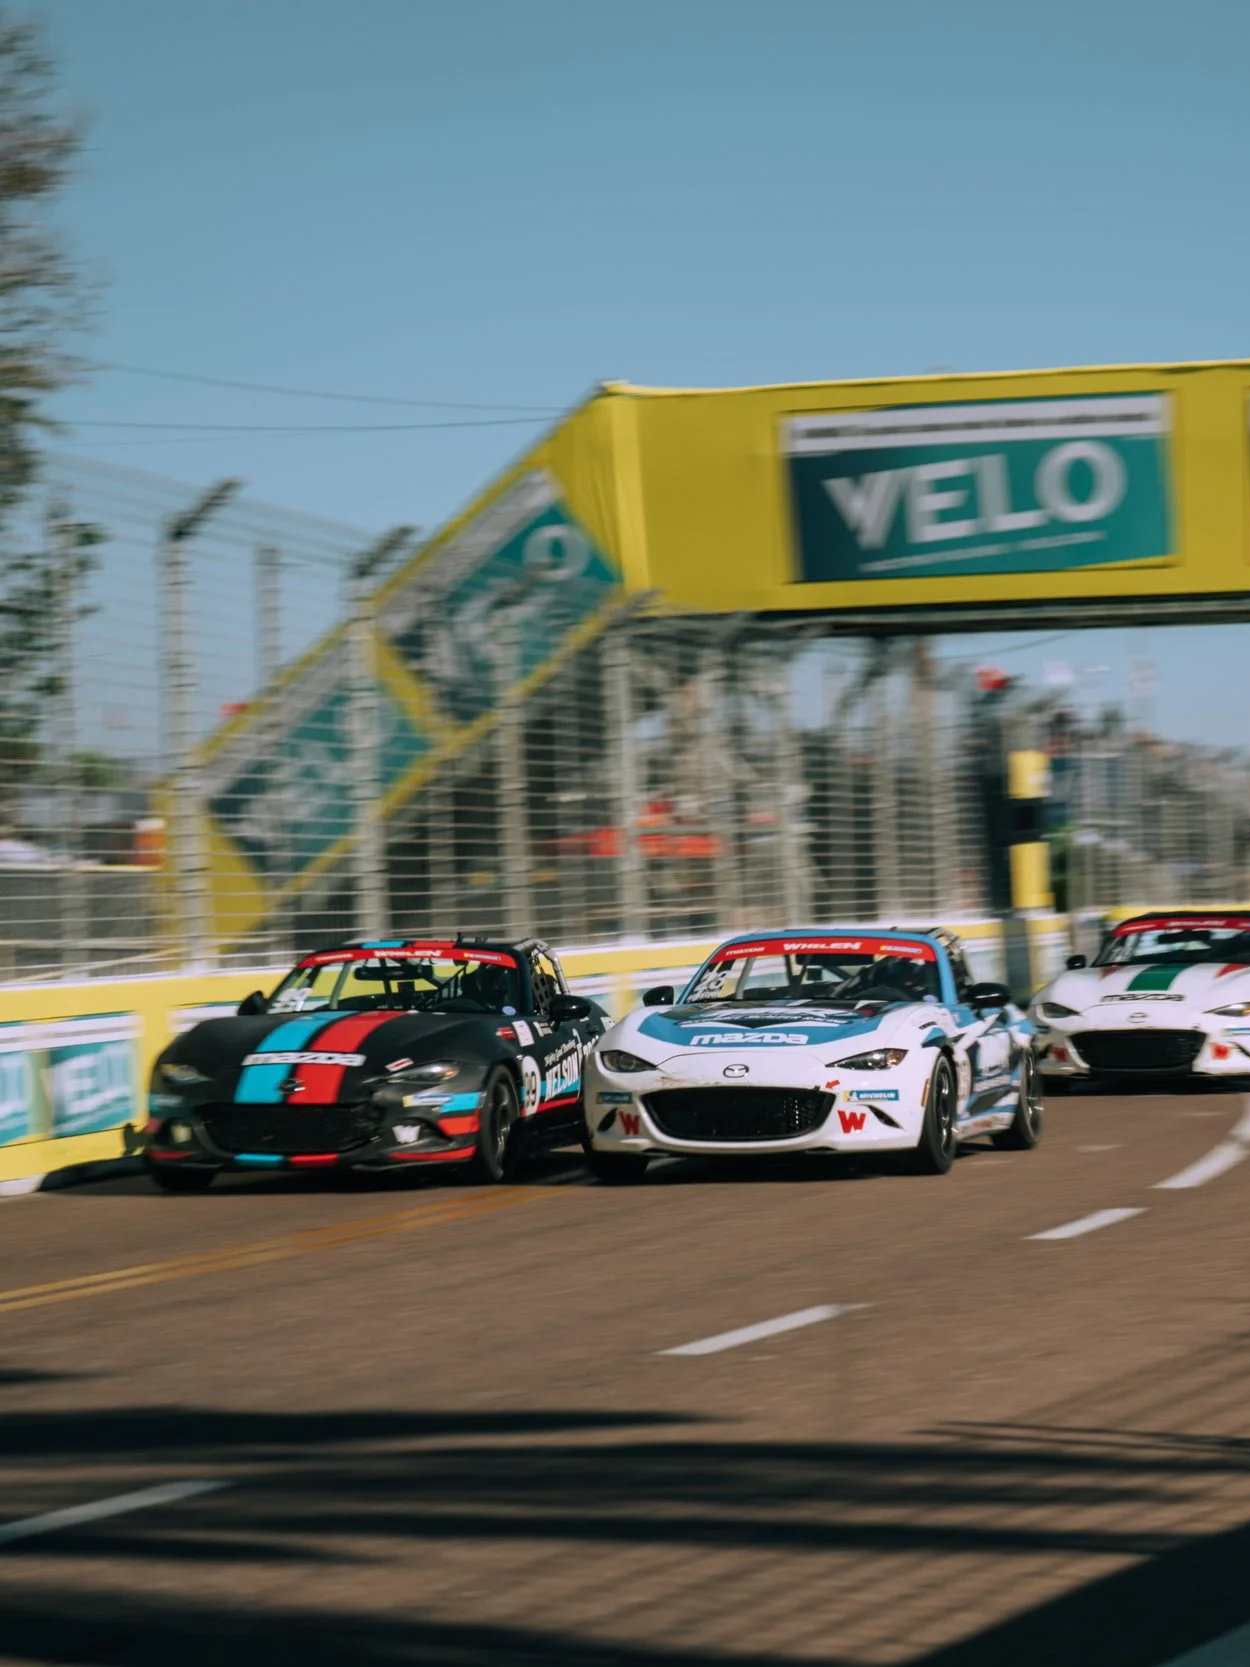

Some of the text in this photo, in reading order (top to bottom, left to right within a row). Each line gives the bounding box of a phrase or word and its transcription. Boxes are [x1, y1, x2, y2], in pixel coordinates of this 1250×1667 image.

[821, 440, 1127, 549] VELO
[783, 942, 862, 951] WHELEN
[690, 1032, 809, 1046] mazda
[544, 1051, 580, 1103] NELSON
[619, 1110, 640, 1136] W
[838, 1110, 866, 1134] W
